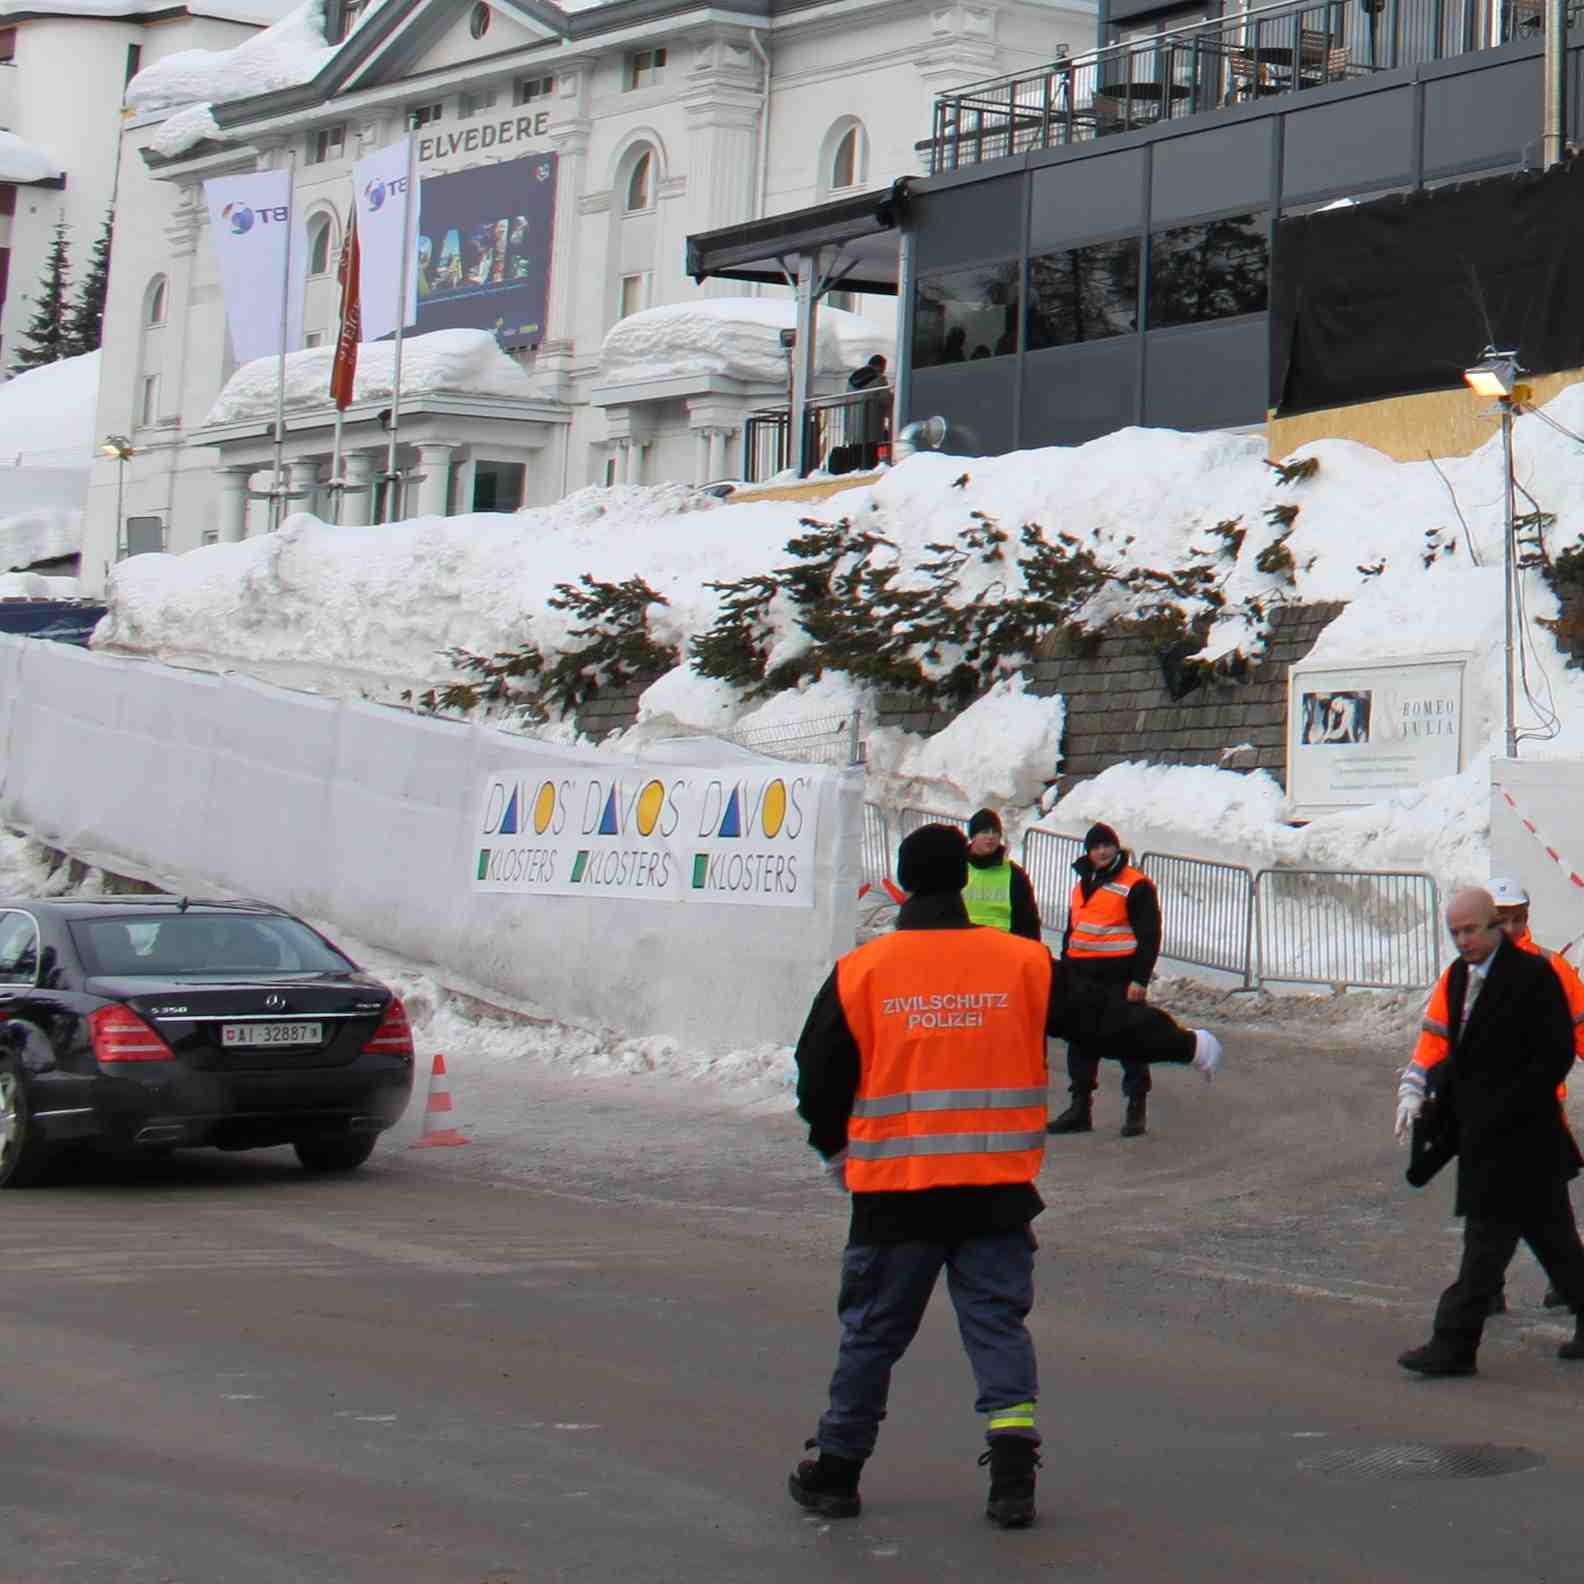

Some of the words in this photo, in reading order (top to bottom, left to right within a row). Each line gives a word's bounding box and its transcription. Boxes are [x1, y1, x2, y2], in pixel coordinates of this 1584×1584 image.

[418, 111, 550, 162] ELVEDERE
[1402, 699, 1455, 716] ROMEO
[1402, 719, 1455, 736] JULIA
[484, 780, 570, 835] DAVOS
[582, 779, 686, 838] DAVOS
[699, 778, 805, 839] DAVOS
[490, 848, 558, 882] KLOSTERS
[586, 850, 672, 888] KLOSTERS
[709, 852, 798, 893] KLOSTERS
[882, 992, 1008, 1015] ZIVILSCHUTZ
[908, 1011, 983, 1030] POLIZEI
[263, 1026, 308, 1042] 32887
